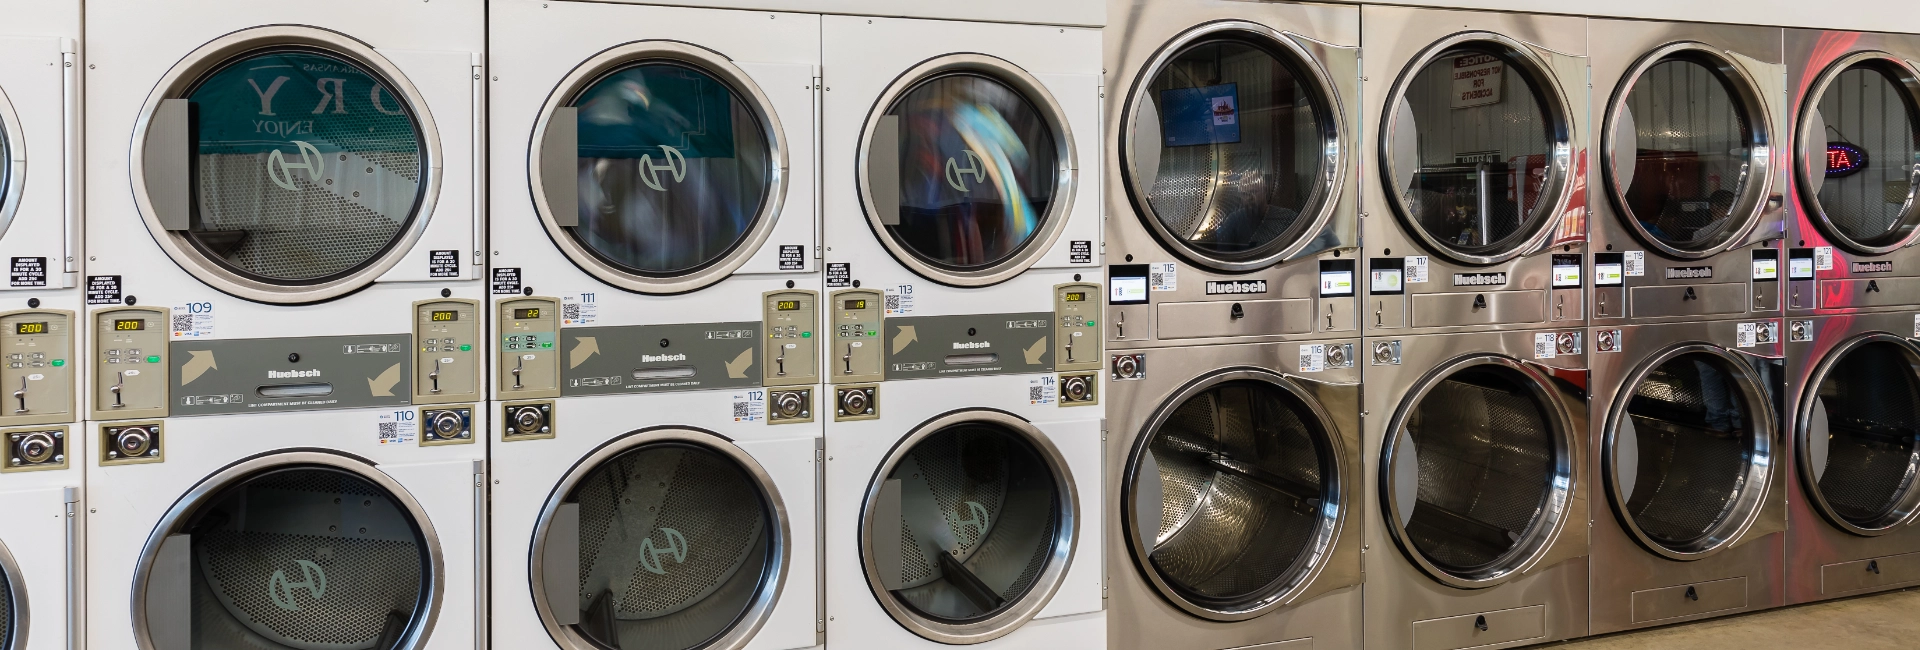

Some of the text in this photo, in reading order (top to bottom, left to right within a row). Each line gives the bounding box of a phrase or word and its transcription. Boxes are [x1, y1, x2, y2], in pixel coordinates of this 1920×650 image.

[1163, 264, 1174, 272] 115
[1852, 262, 1892, 272] Huebsch
[1668, 267, 1712, 278] Huebsch
[1454, 273, 1506, 285] Huebsch
[898, 285, 912, 294] 113
[1207, 280, 1266, 294] Huebsch
[580, 293, 595, 302] 111
[186, 302, 212, 313] 109
[433, 312, 452, 320] 200
[527, 310, 539, 318] 22
[20, 324, 42, 333] 200
[117, 321, 138, 330] 200
[953, 341, 990, 349] Huebsch
[1310, 346, 1322, 354] 116
[642, 353, 686, 362] Huebsch
[268, 368, 320, 378] Huebsch
[1041, 376, 1055, 385] 114
[748, 391, 763, 401] 112
[394, 410, 414, 421] 110
